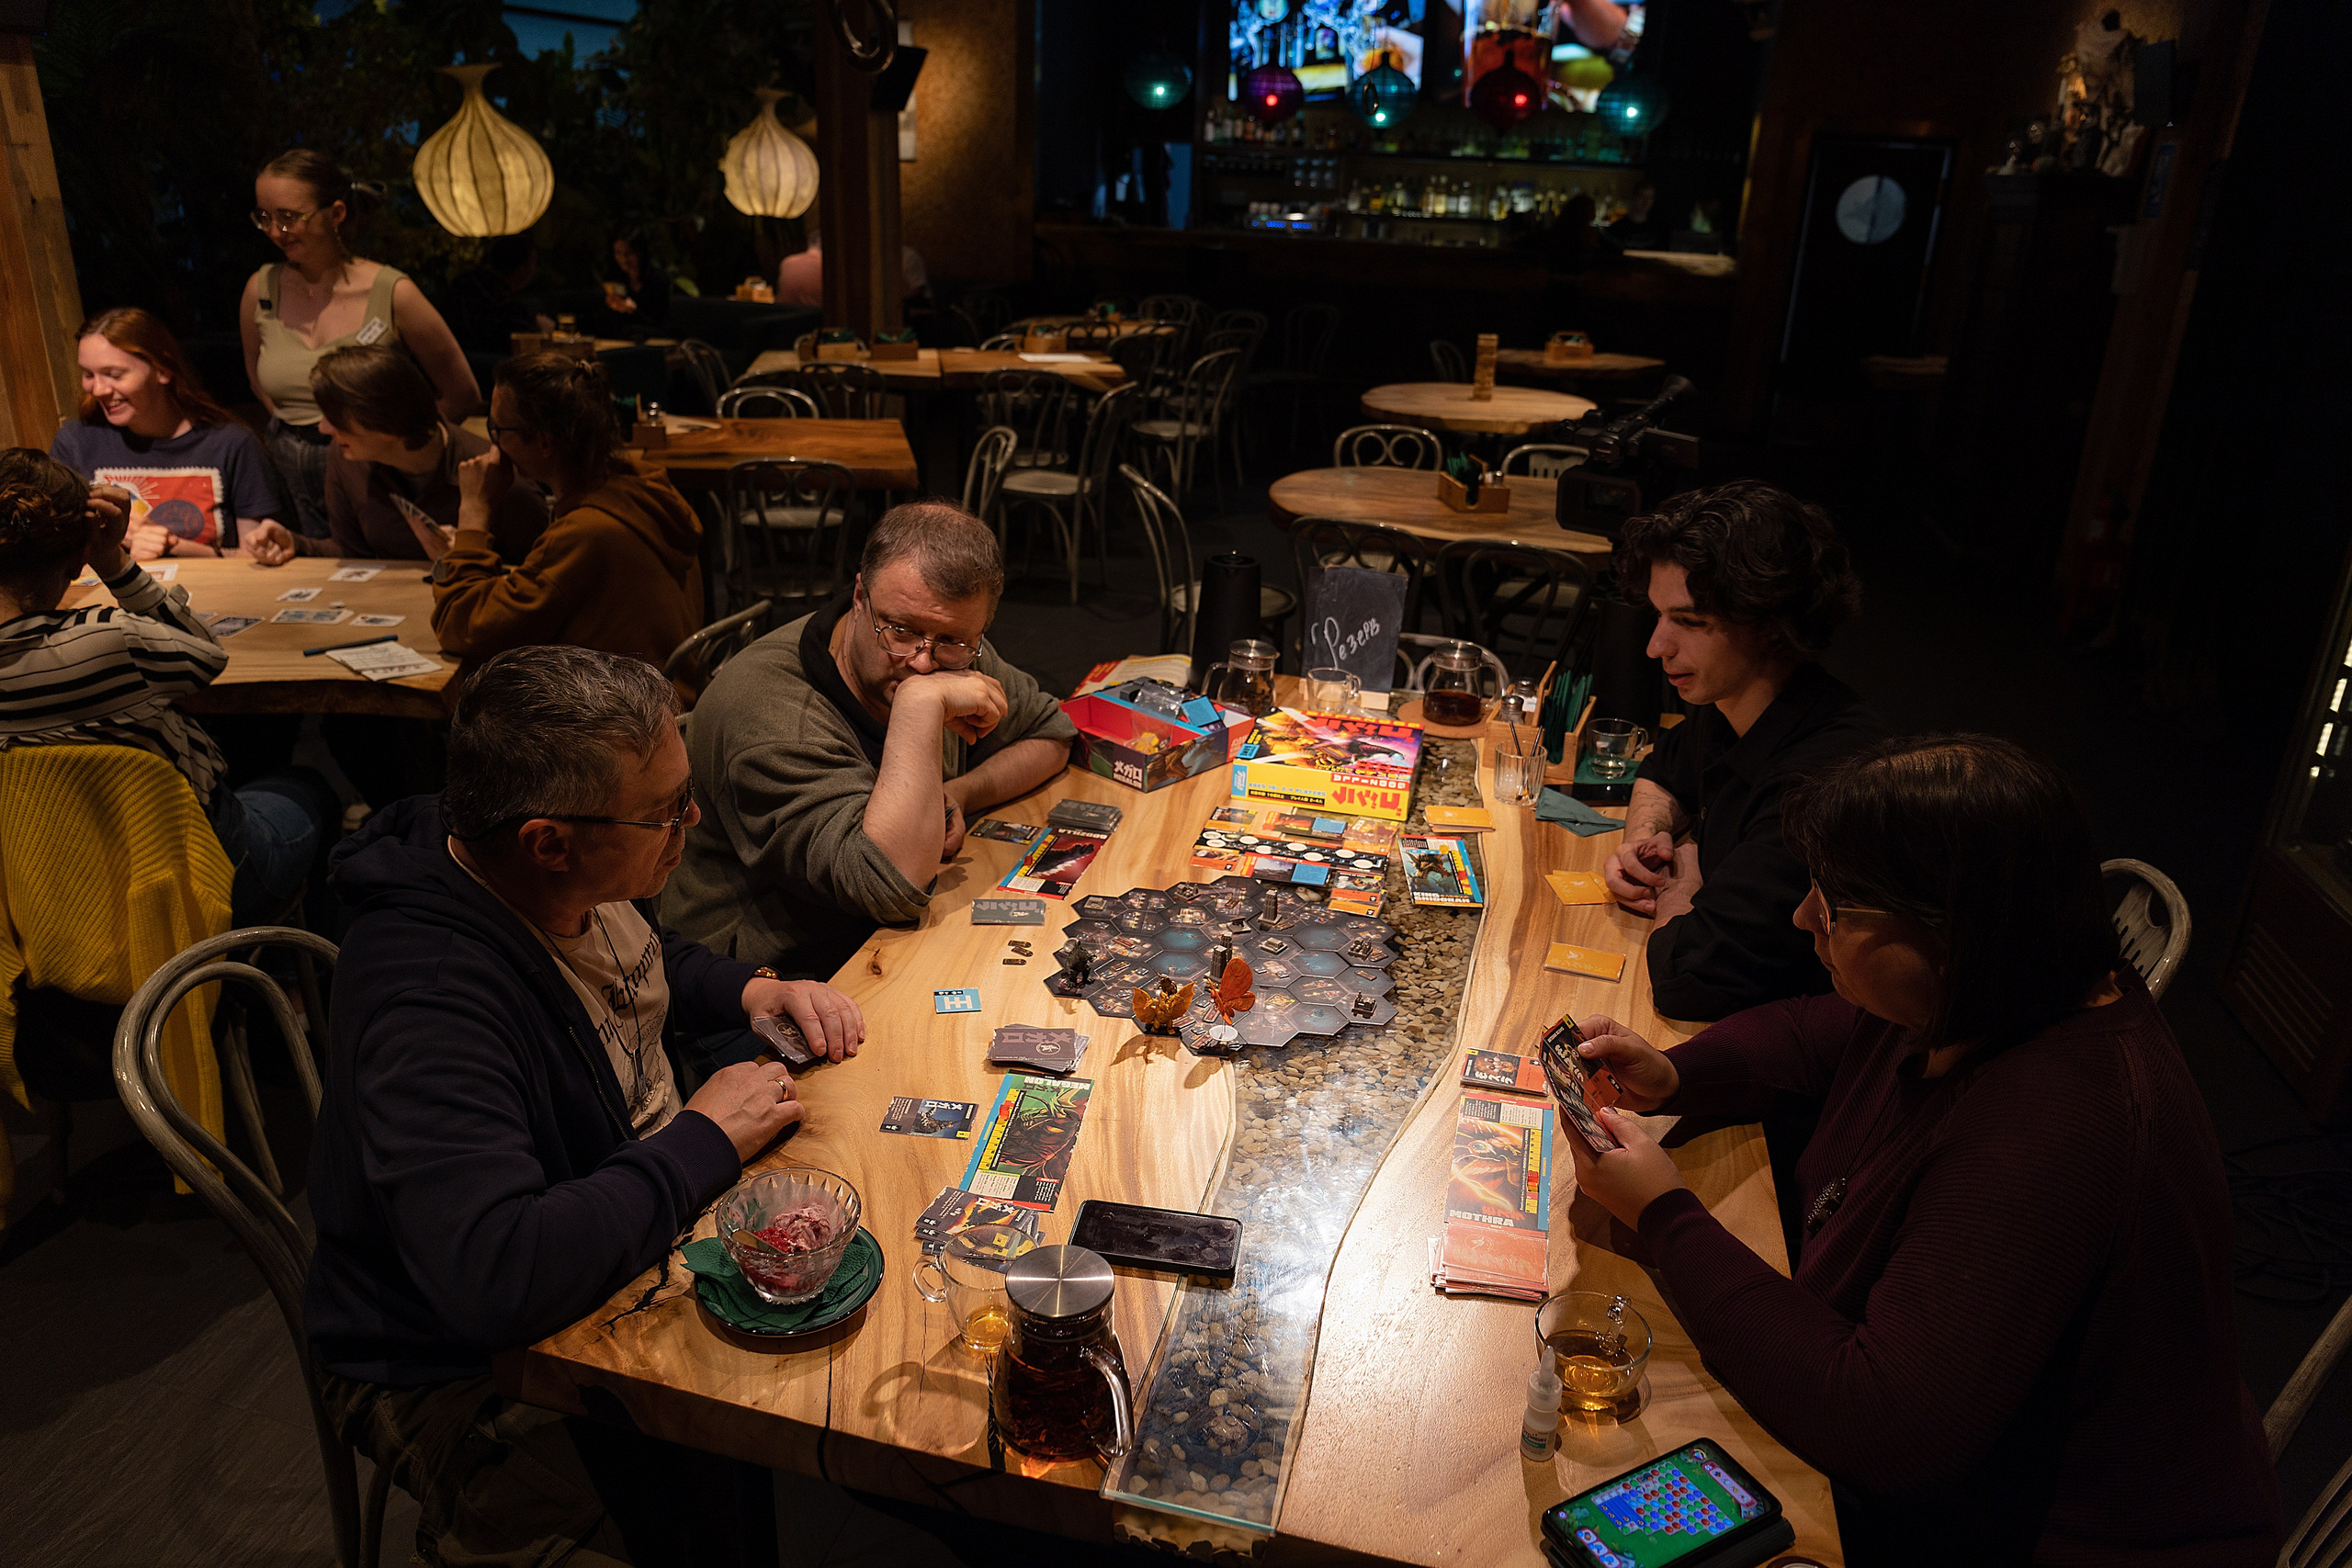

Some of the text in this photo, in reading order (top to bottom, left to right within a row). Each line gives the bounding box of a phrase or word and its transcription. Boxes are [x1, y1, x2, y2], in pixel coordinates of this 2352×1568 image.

[1333, 774, 1406, 790] GODZILLA
[1023, 1076, 1091, 1090] MEGALON
[1449, 1209, 1515, 1227] MOTHRA
